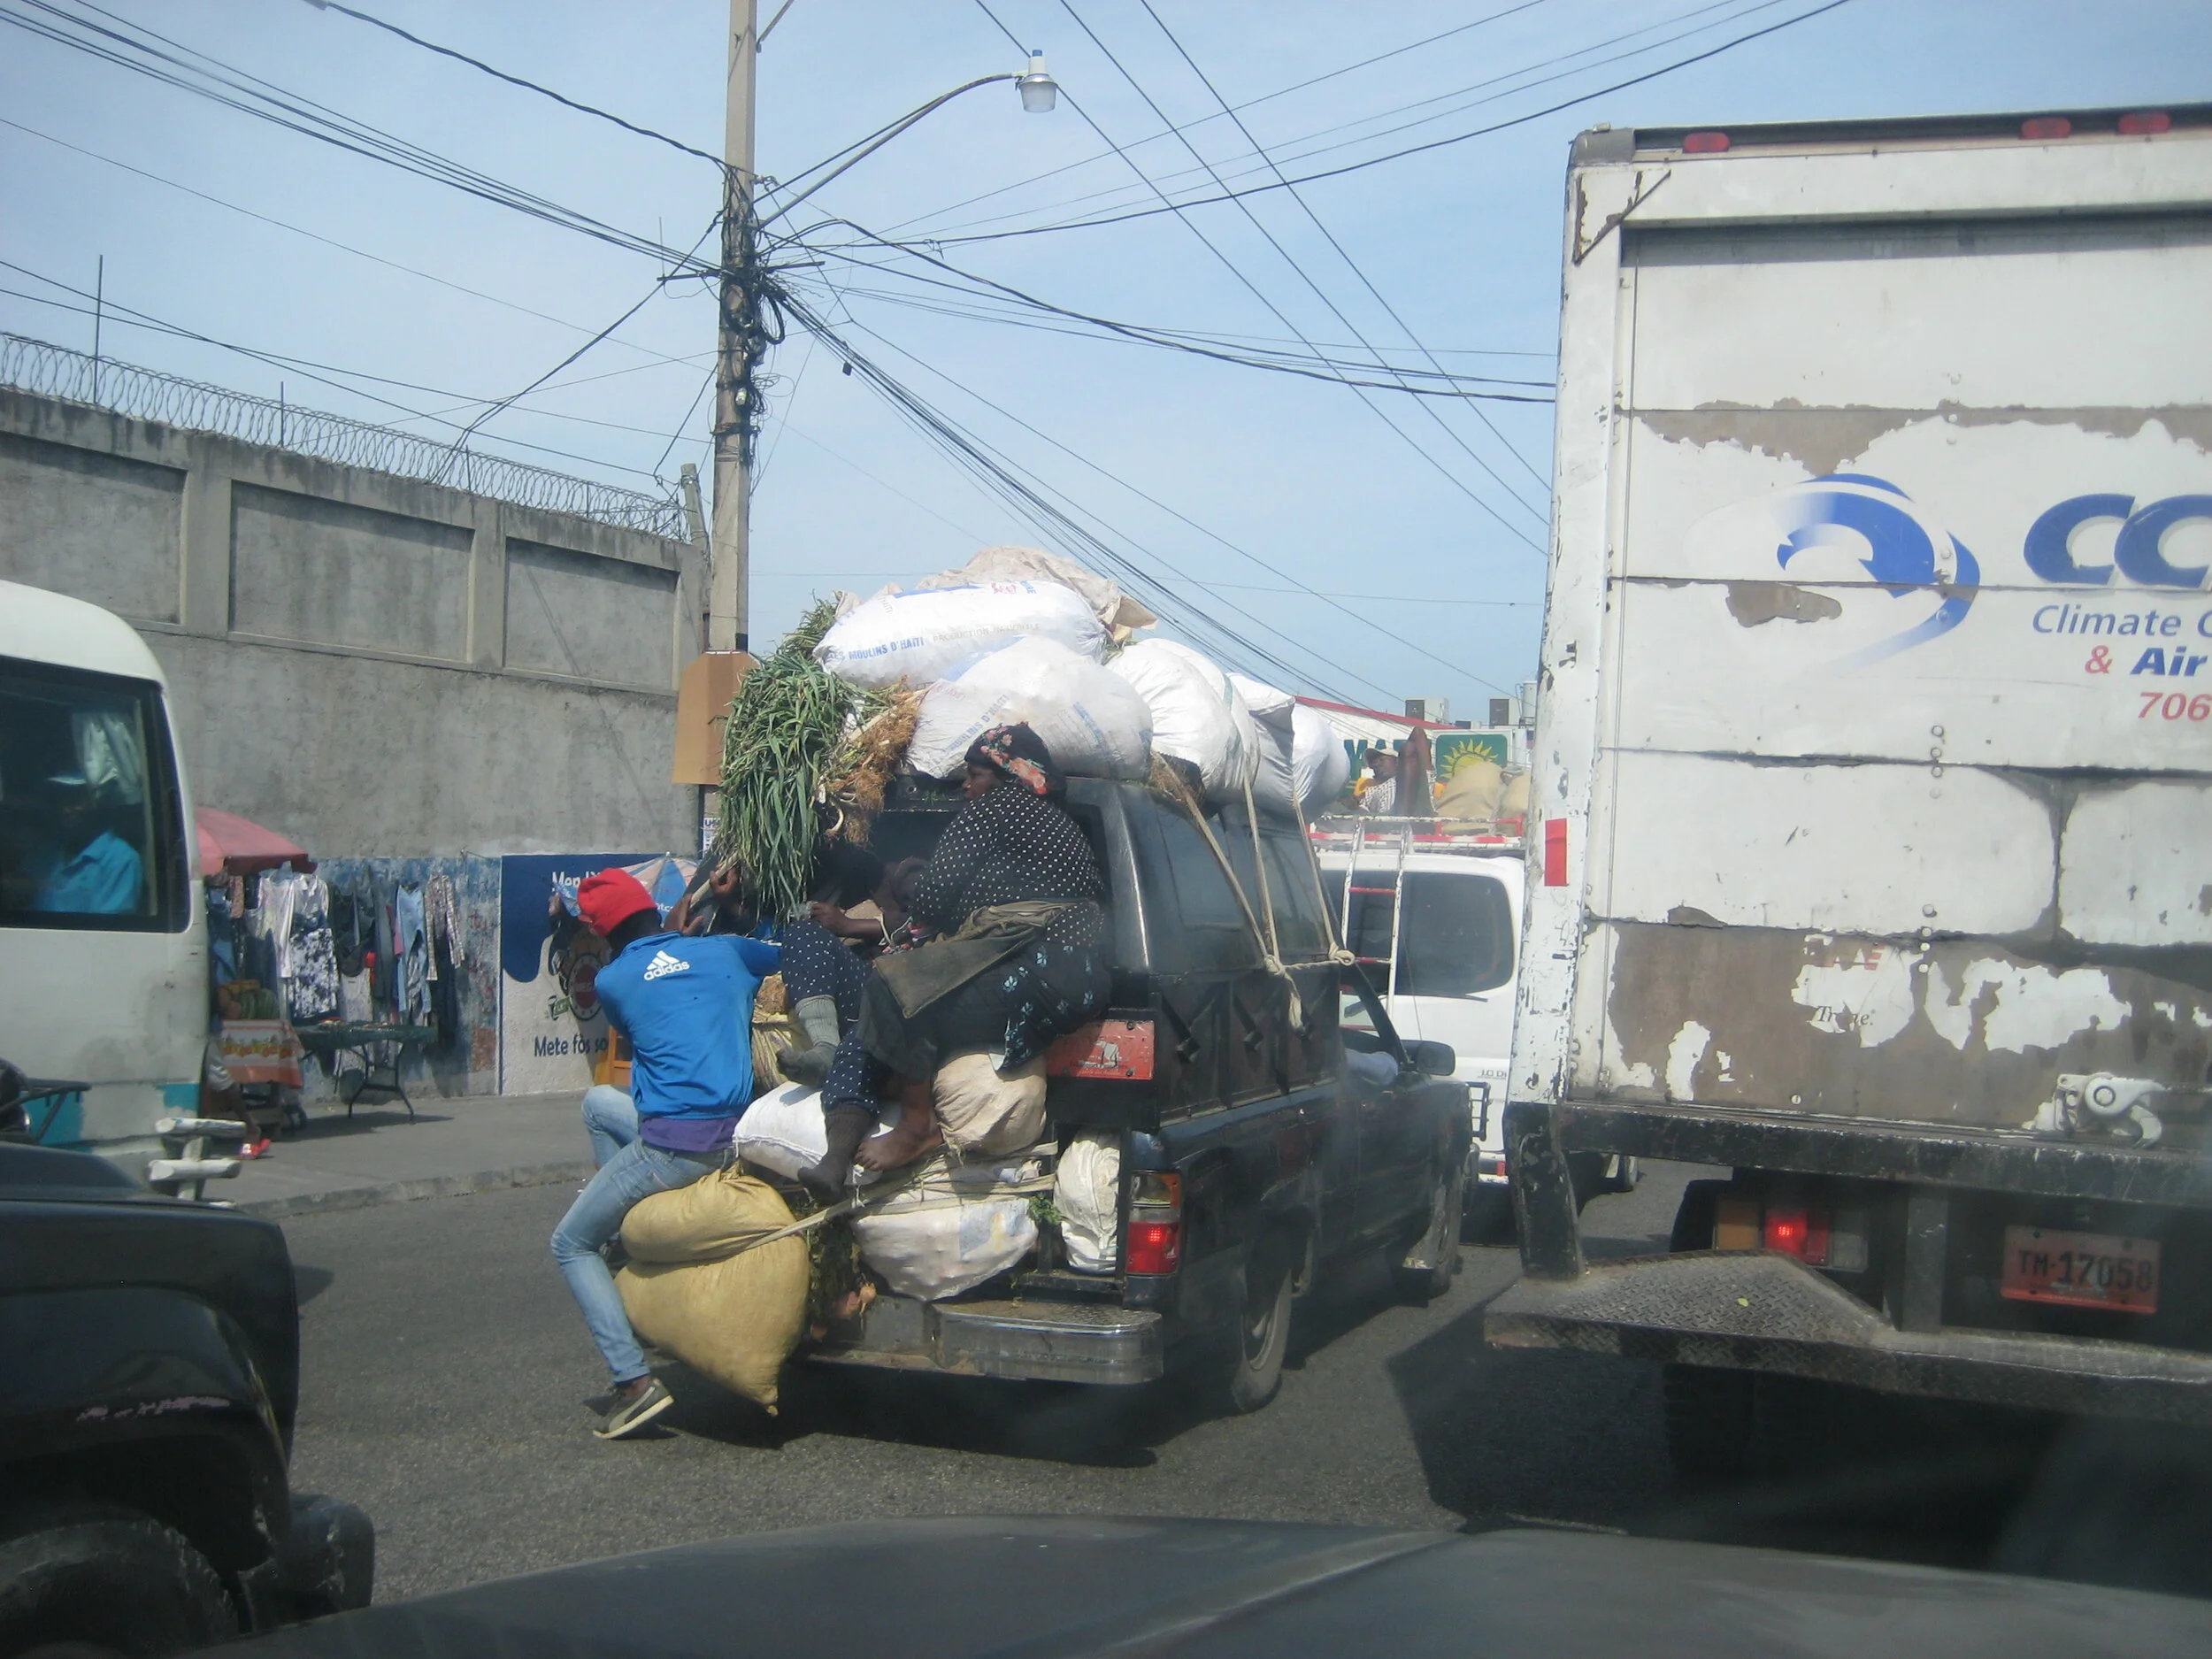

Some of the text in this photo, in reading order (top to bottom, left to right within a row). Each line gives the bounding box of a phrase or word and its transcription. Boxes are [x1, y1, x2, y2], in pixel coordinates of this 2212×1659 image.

[2032, 604, 2182, 636] Climate
[932, 626, 990, 644] PRODUCTION
[848, 643, 889, 661] MOULINS
[890, 636, 925, 653] D'HAITI
[2085, 645, 2209, 677] & Air
[2138, 692, 2212, 721] 706
[643, 961, 690, 981] adidas
[534, 1035, 569, 1057] Mete
